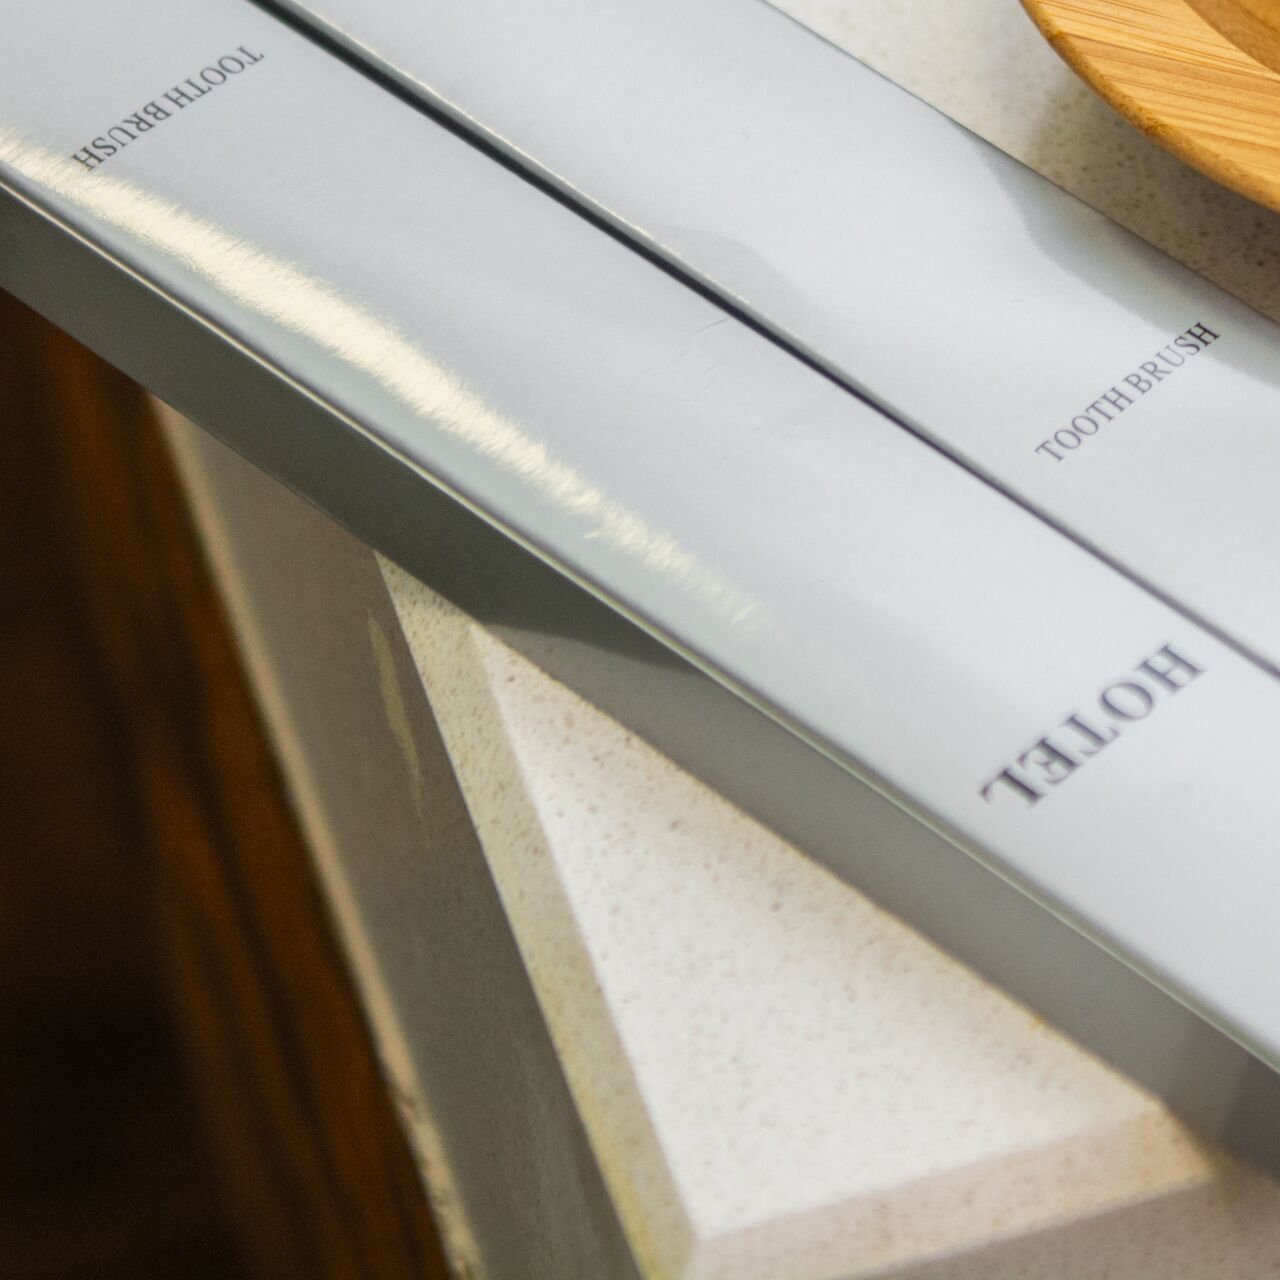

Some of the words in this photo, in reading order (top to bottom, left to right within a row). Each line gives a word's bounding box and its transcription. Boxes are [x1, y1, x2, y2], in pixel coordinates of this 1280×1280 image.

[161, 45, 265, 110] TOOTH
[70, 100, 173, 171] BRUSH
[1033, 385, 1136, 463] TOOTH
[1121, 321, 1221, 396] BRUSH
[978, 643, 1208, 810] HOTEL
